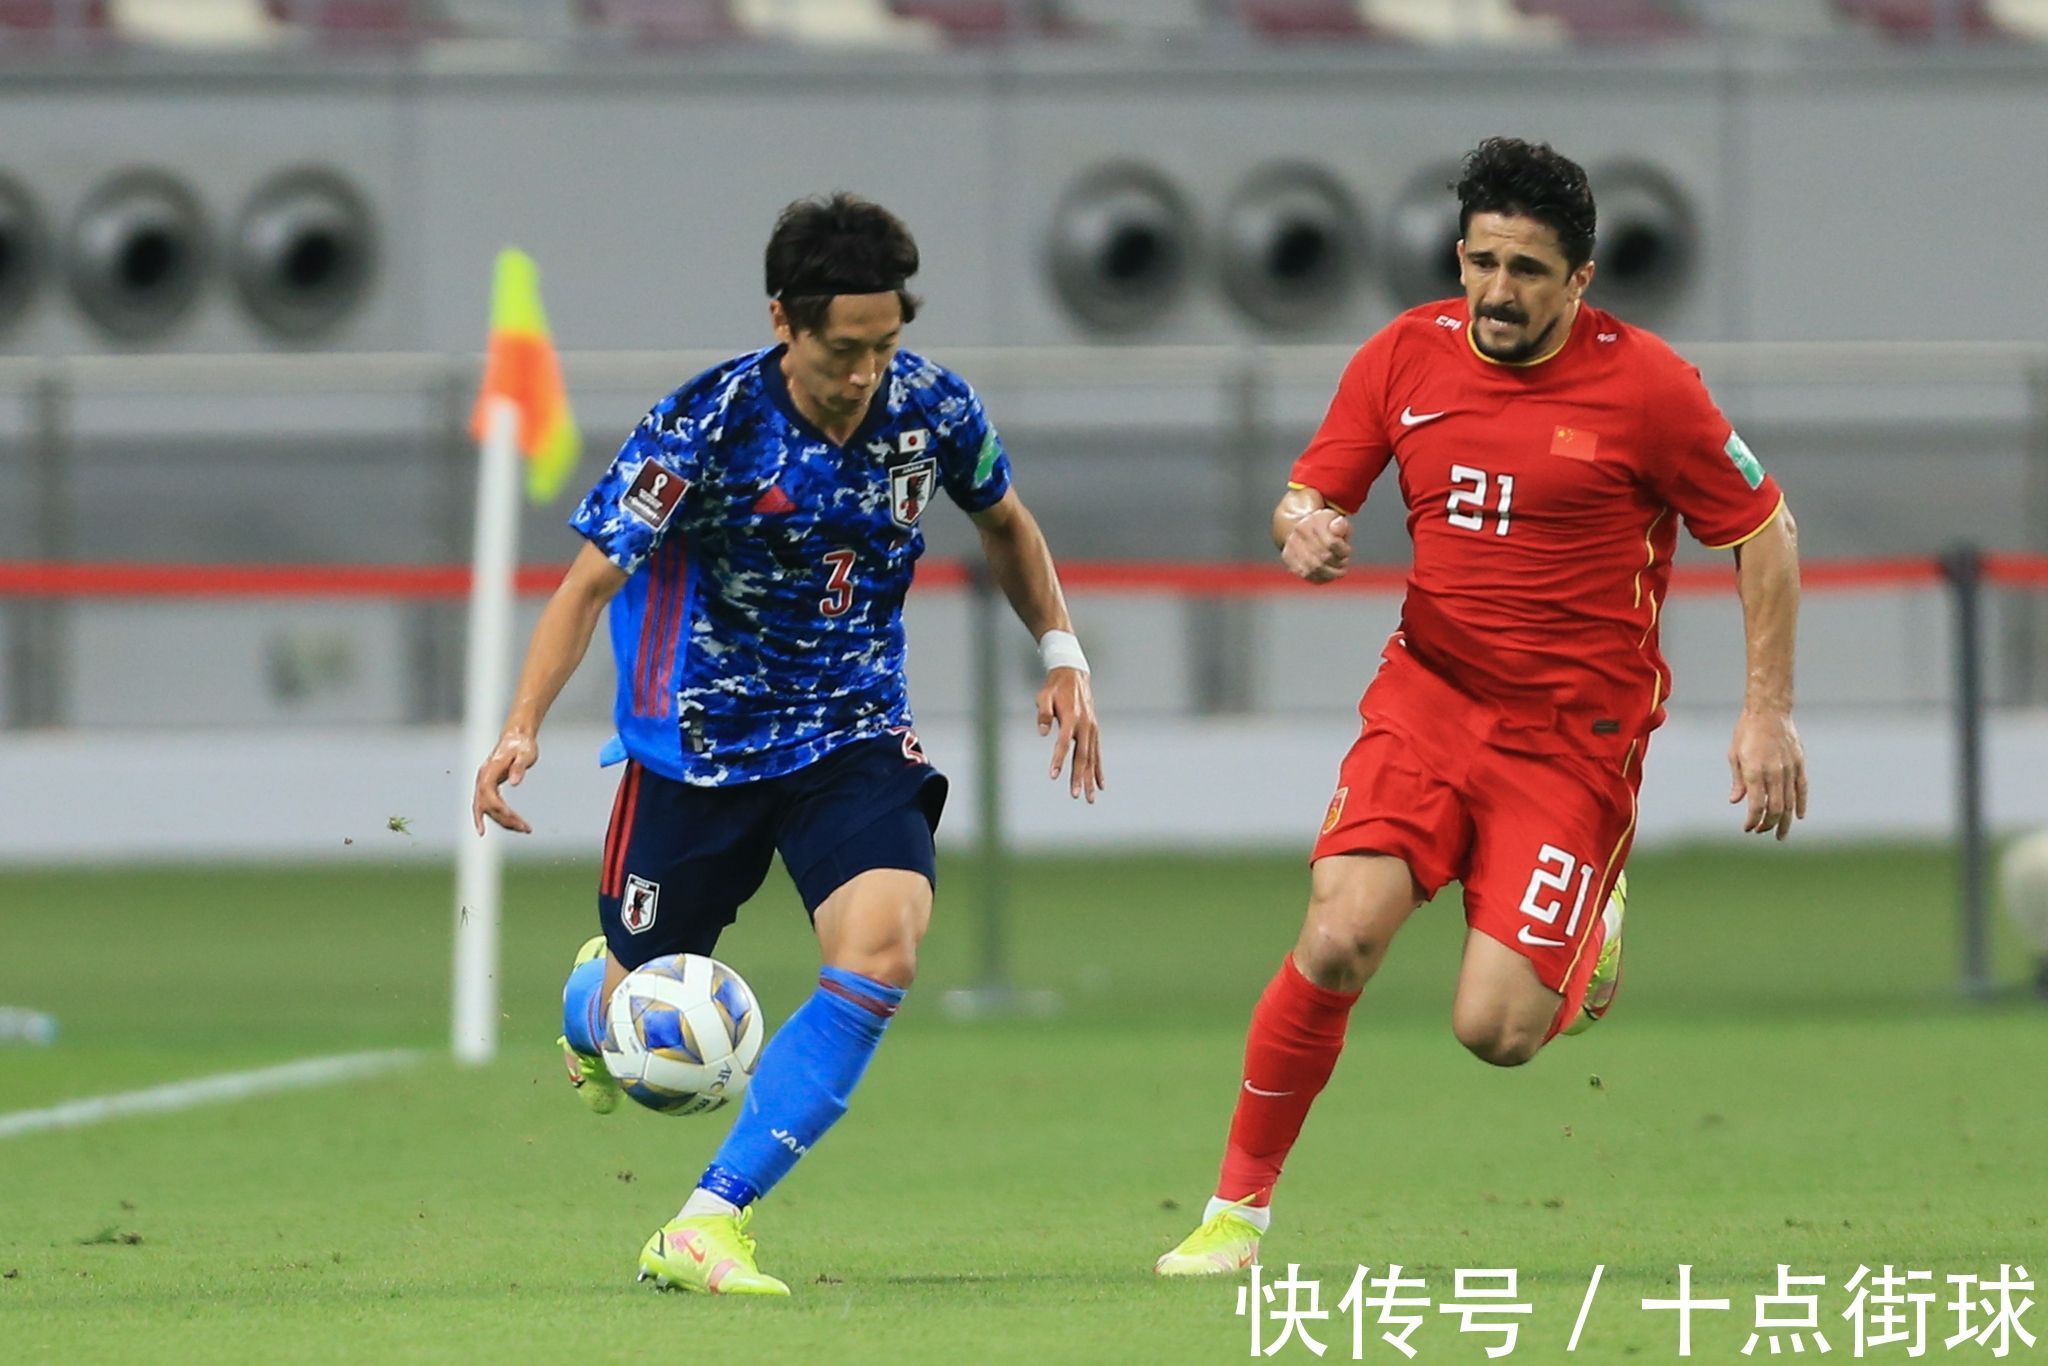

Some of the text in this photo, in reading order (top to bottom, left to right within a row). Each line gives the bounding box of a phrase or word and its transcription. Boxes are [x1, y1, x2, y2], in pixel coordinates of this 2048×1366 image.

[1446, 463, 1514, 536] 21
[819, 549, 857, 617] 3
[1519, 842, 1594, 937] 21
